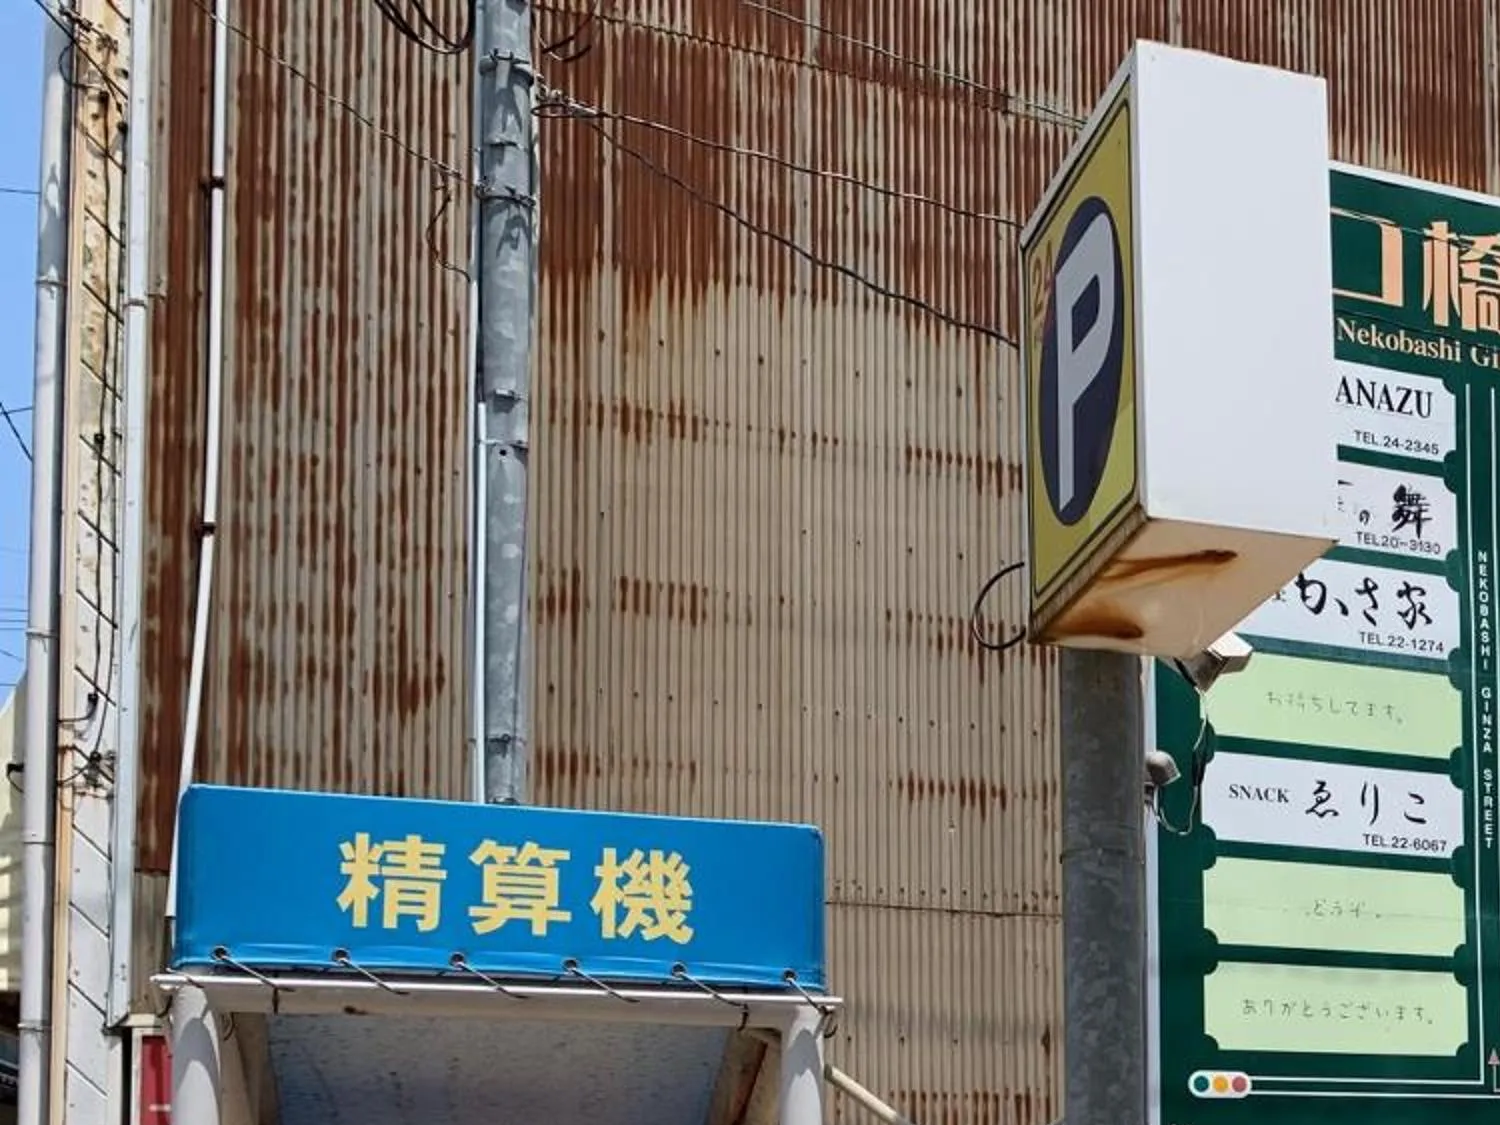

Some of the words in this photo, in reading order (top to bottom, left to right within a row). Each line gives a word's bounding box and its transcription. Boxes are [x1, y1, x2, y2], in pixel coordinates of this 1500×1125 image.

[1056, 212, 1115, 512] P
[1336, 317, 1461, 362] Nekobashi
[1477, 551, 1491, 671] NEKOBASHI
[1481, 687, 1493, 753] GINZA
[1229, 783, 1290, 803] SNACK
[1483, 769, 1495, 849] STREET
[336, 832, 694, 944] 精算機
